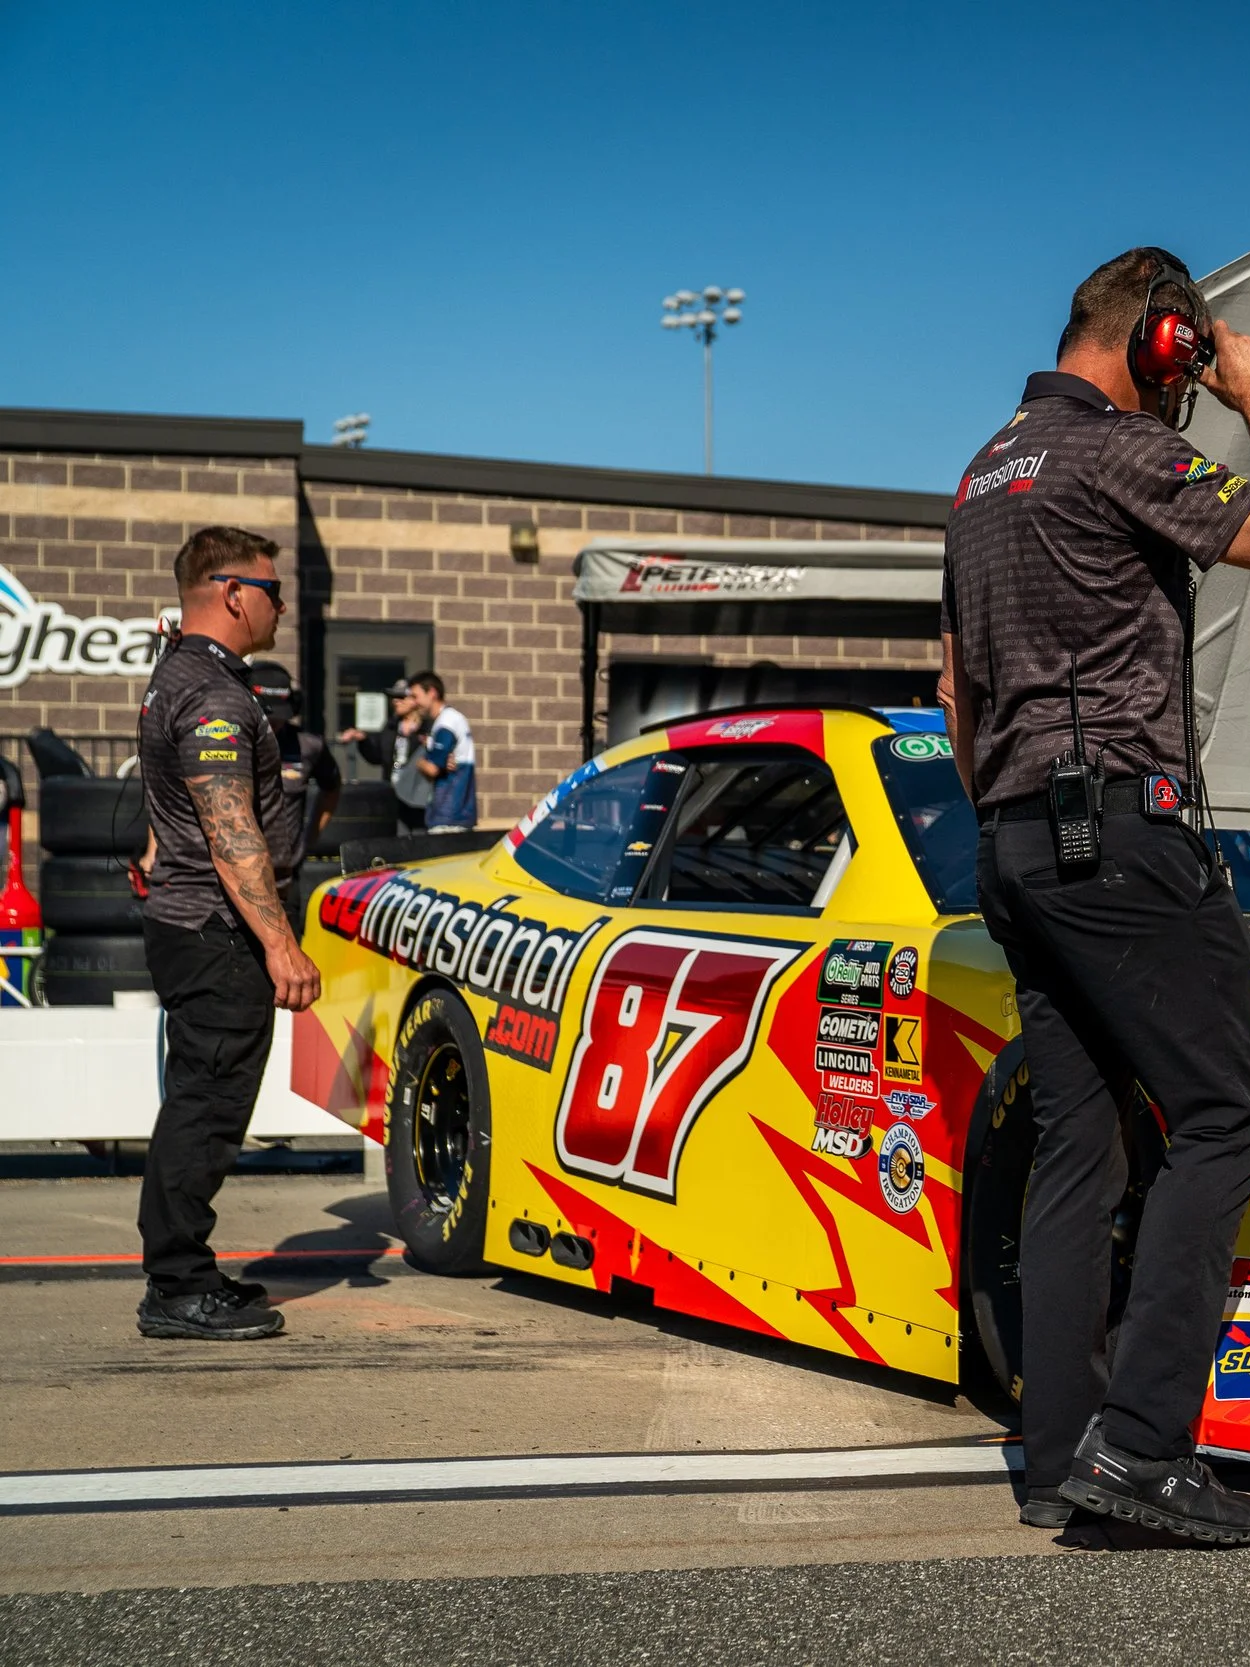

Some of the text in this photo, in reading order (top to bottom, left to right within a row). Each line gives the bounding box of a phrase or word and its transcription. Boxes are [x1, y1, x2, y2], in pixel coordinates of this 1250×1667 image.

[863, 961, 881, 975] AUTO
[894, 950, 917, 967] NASCAR
[860, 974, 881, 988] PARTS
[889, 977, 914, 996] SALUTES
[840, 993, 860, 1006] SERIES
[819, 1015, 879, 1042] COMETIC
[556, 930, 801, 1197] 87
[817, 1051, 869, 1073] LINCOLN
[829, 1074, 874, 1095] WELDERS
[885, 1066, 921, 1082] KENNAMETAL
[815, 1093, 875, 1140] Holley
[811, 1127, 866, 1159] MSD
[884, 1127, 922, 1157] CHAMPION
[882, 1176, 921, 1209] IRRIGATION
